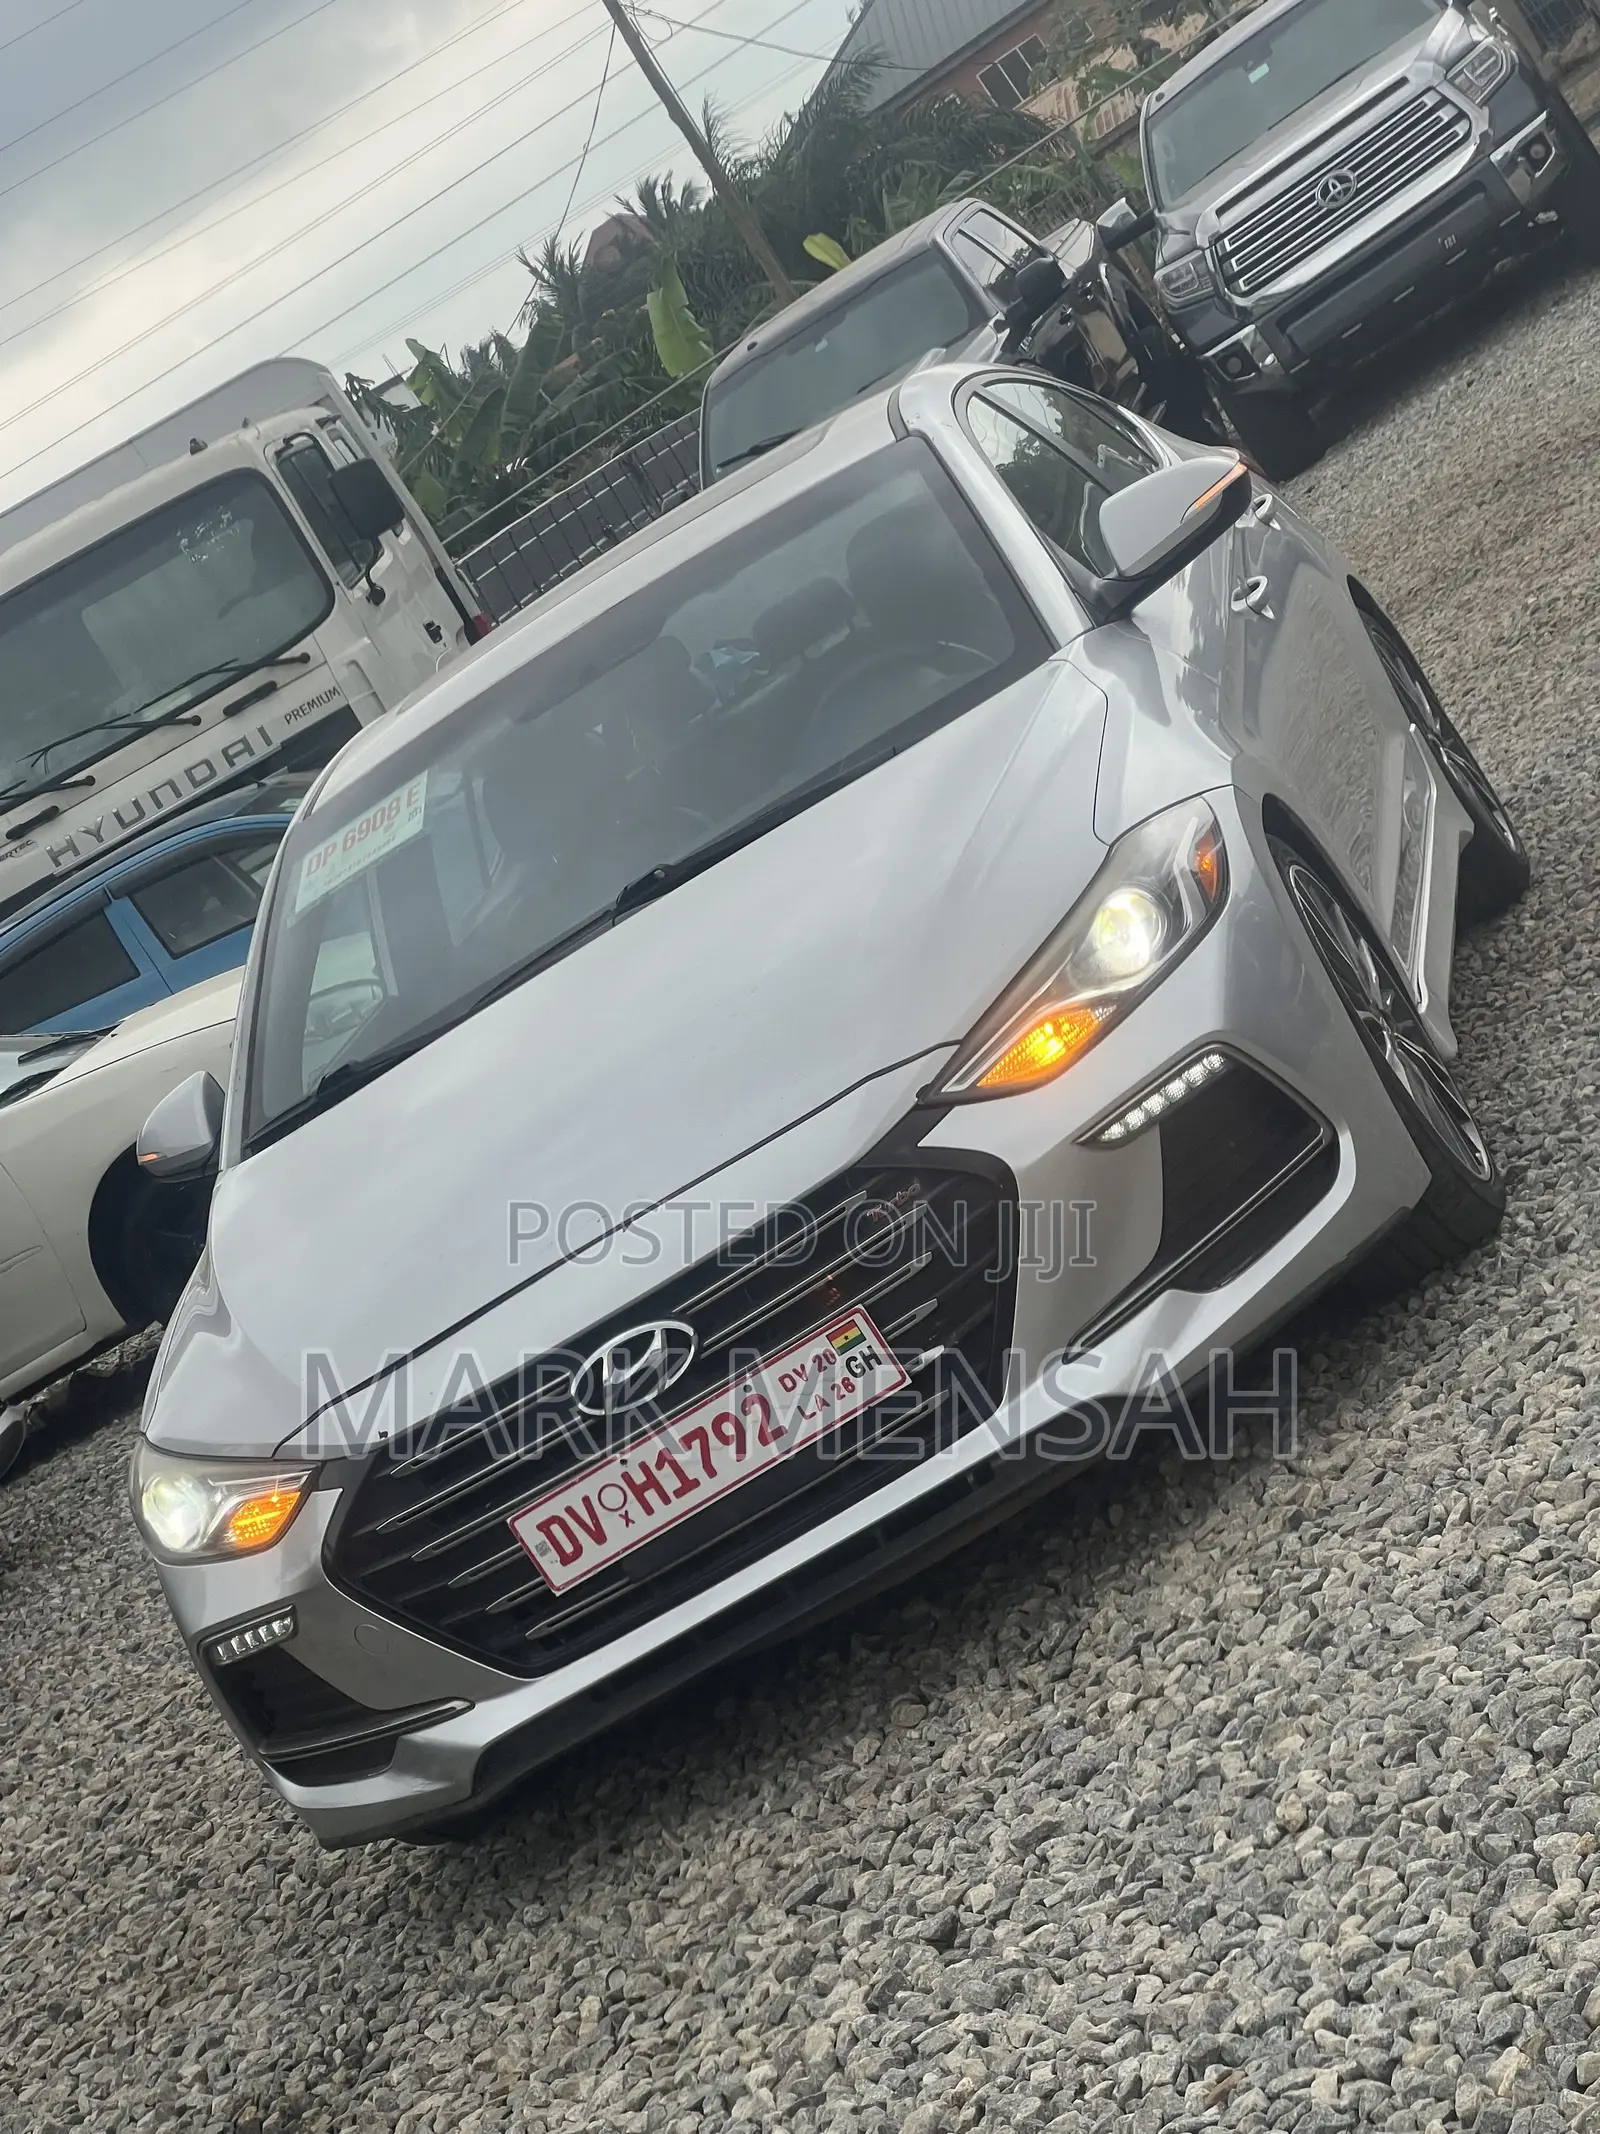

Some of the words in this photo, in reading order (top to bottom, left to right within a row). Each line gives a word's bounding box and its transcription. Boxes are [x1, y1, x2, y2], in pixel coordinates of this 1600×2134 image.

[284, 686, 341, 725] PREMIUM
[45, 725, 274, 868] HYUNDAI
[306, 842, 338, 876] DP
[342, 795, 401, 852] 6908
[406, 781, 422, 808] E
[778, 1363, 809, 1393] DV
[812, 1348, 837, 1373] 20
[845, 1344, 882, 1379] GH
[797, 1394, 831, 1420] LA
[536, 1494, 608, 1567] DV
[620, 1393, 789, 1517] H1792
